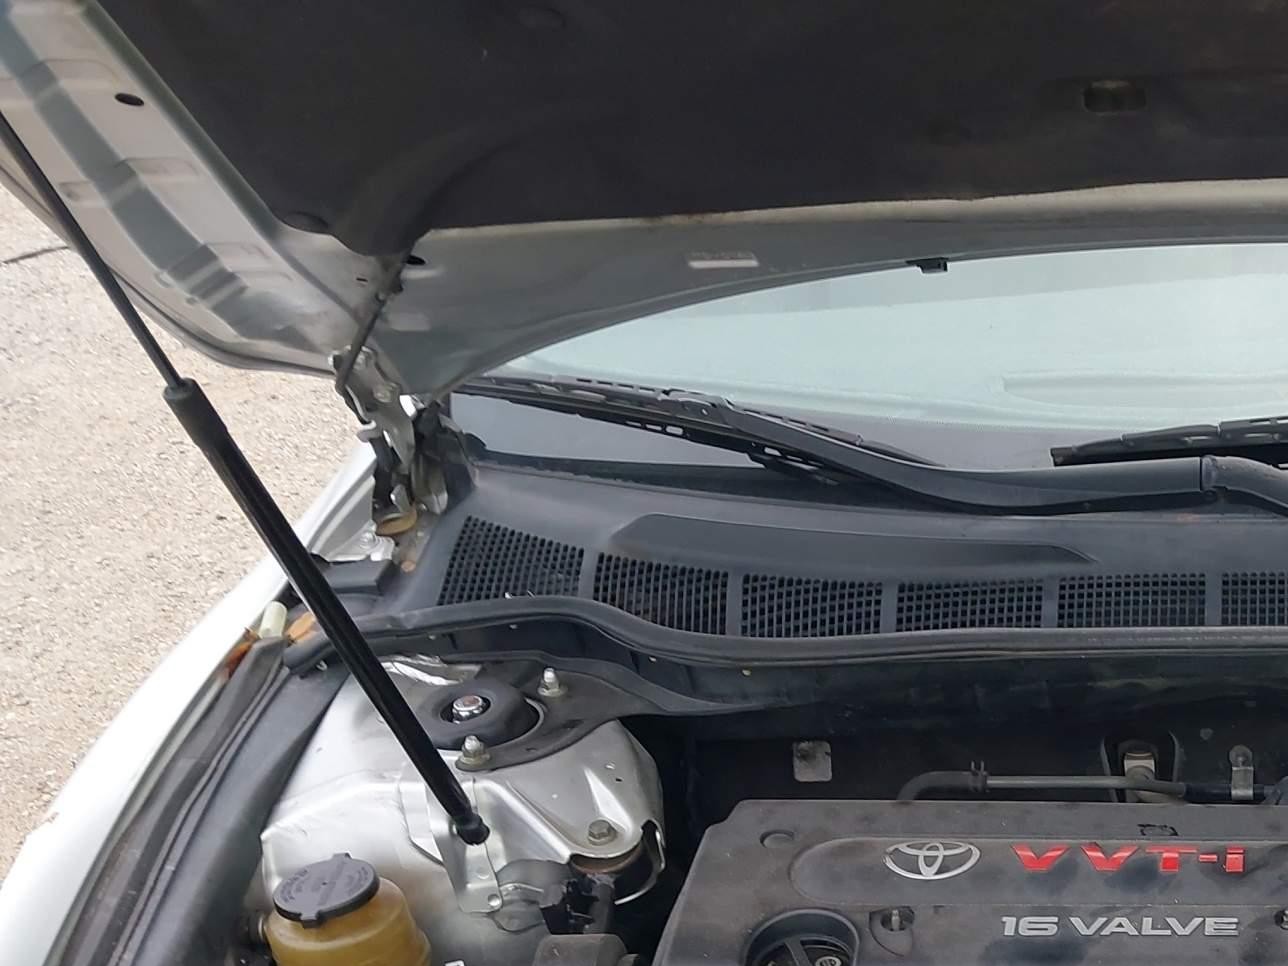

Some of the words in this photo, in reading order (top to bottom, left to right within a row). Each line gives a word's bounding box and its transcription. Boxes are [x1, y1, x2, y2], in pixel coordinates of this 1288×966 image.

[1011, 843, 1244, 872] VVT-i
[1002, 917, 1059, 937] 16
[1071, 917, 1239, 937] VALVE
